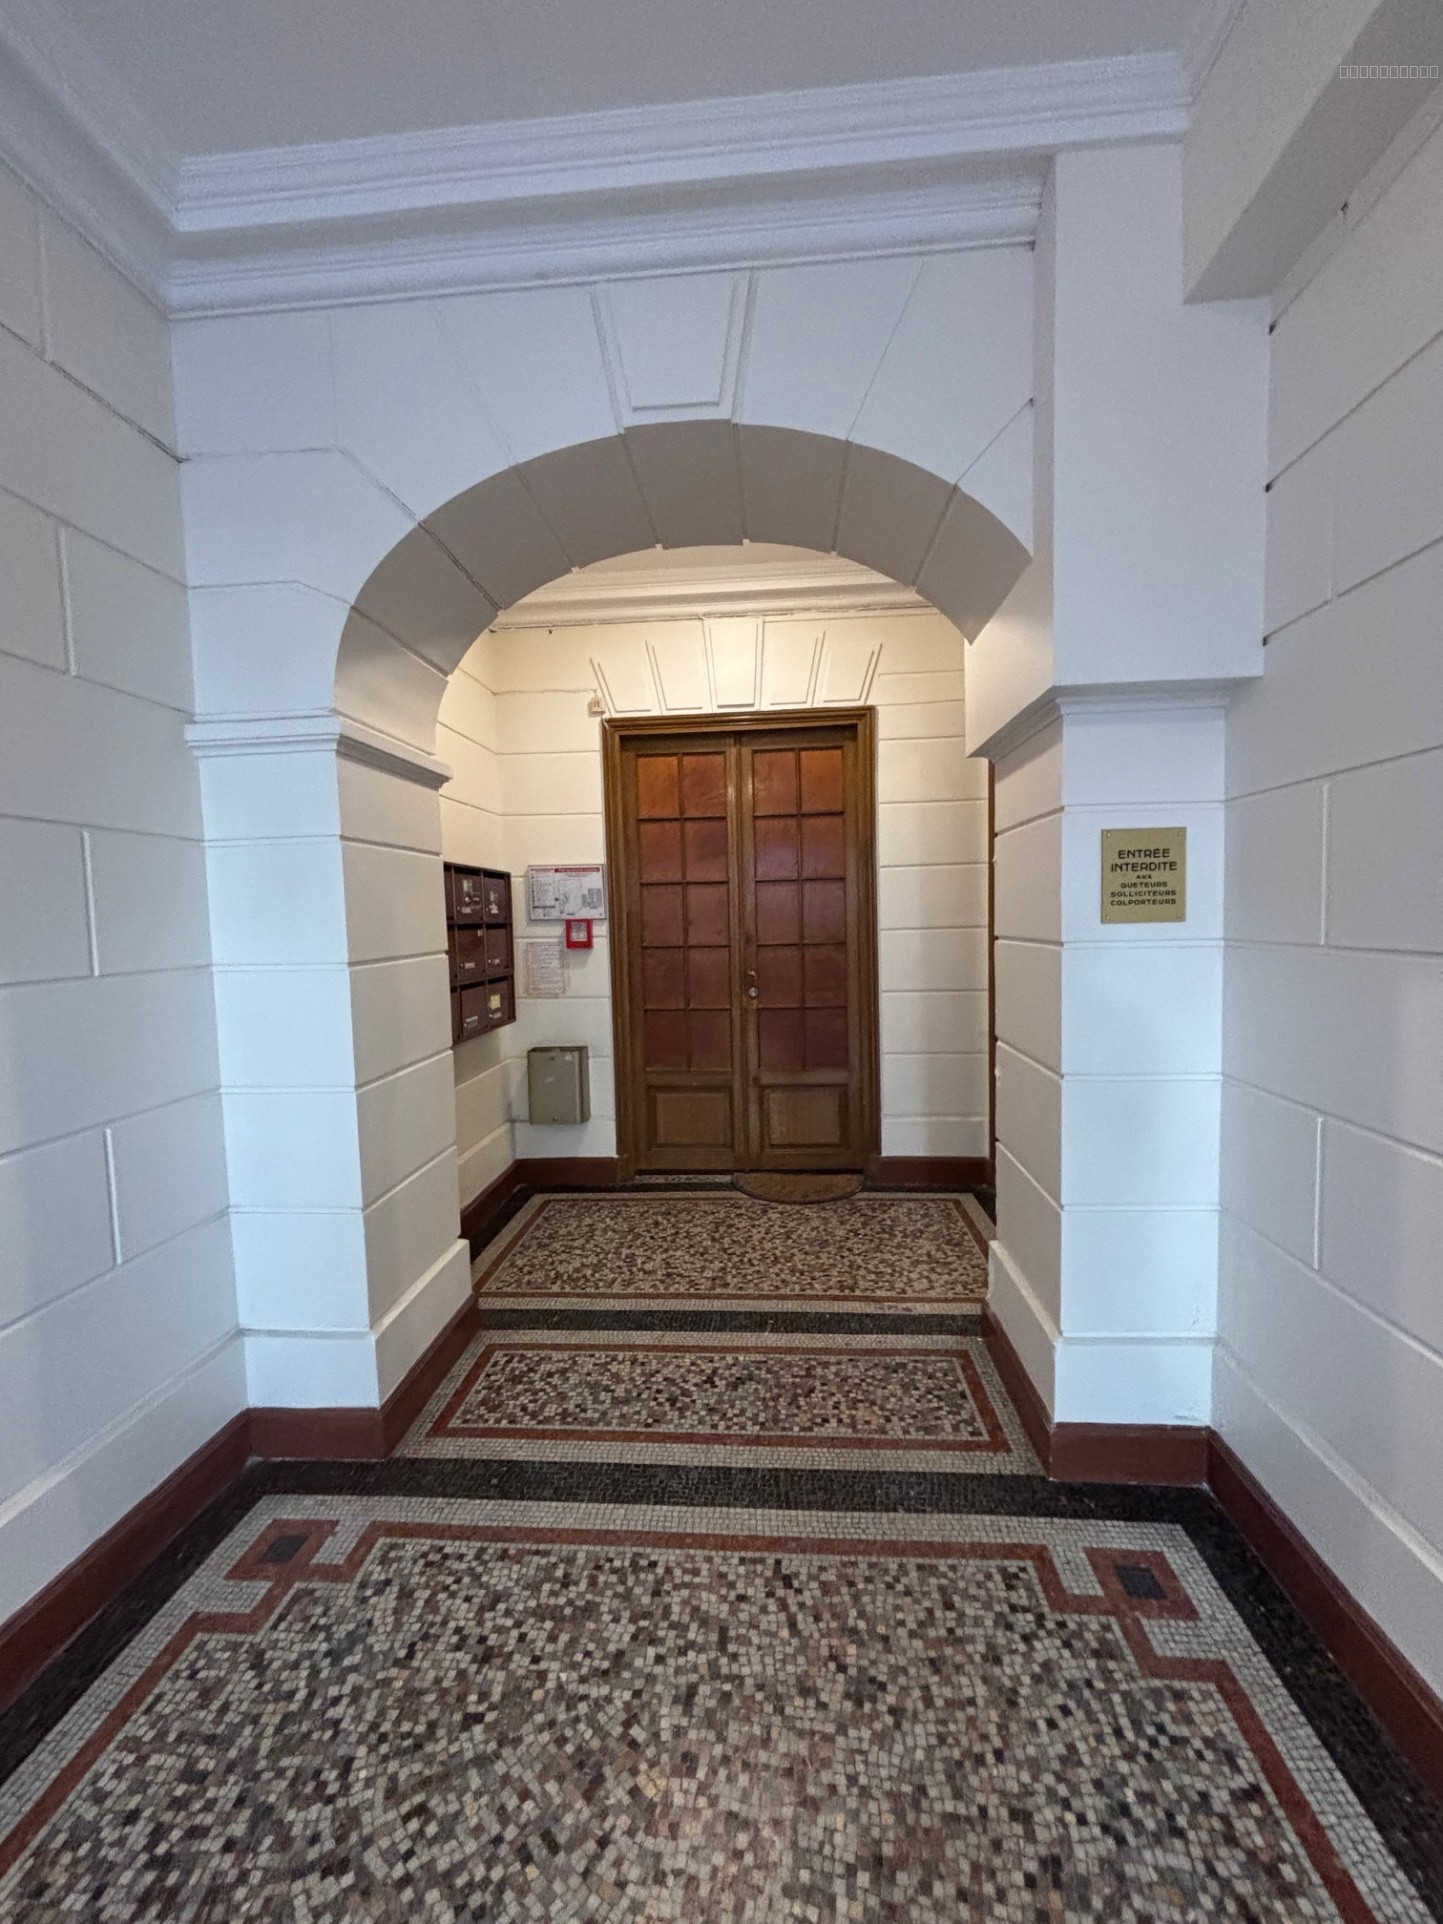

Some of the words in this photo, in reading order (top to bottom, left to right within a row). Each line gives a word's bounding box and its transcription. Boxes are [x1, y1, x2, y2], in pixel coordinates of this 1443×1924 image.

[1110, 861, 1177, 873] INTERDITE
[1110, 889, 1177, 898] SOLLICITEURS
[1110, 898, 1177, 906] COLPORTEURS
